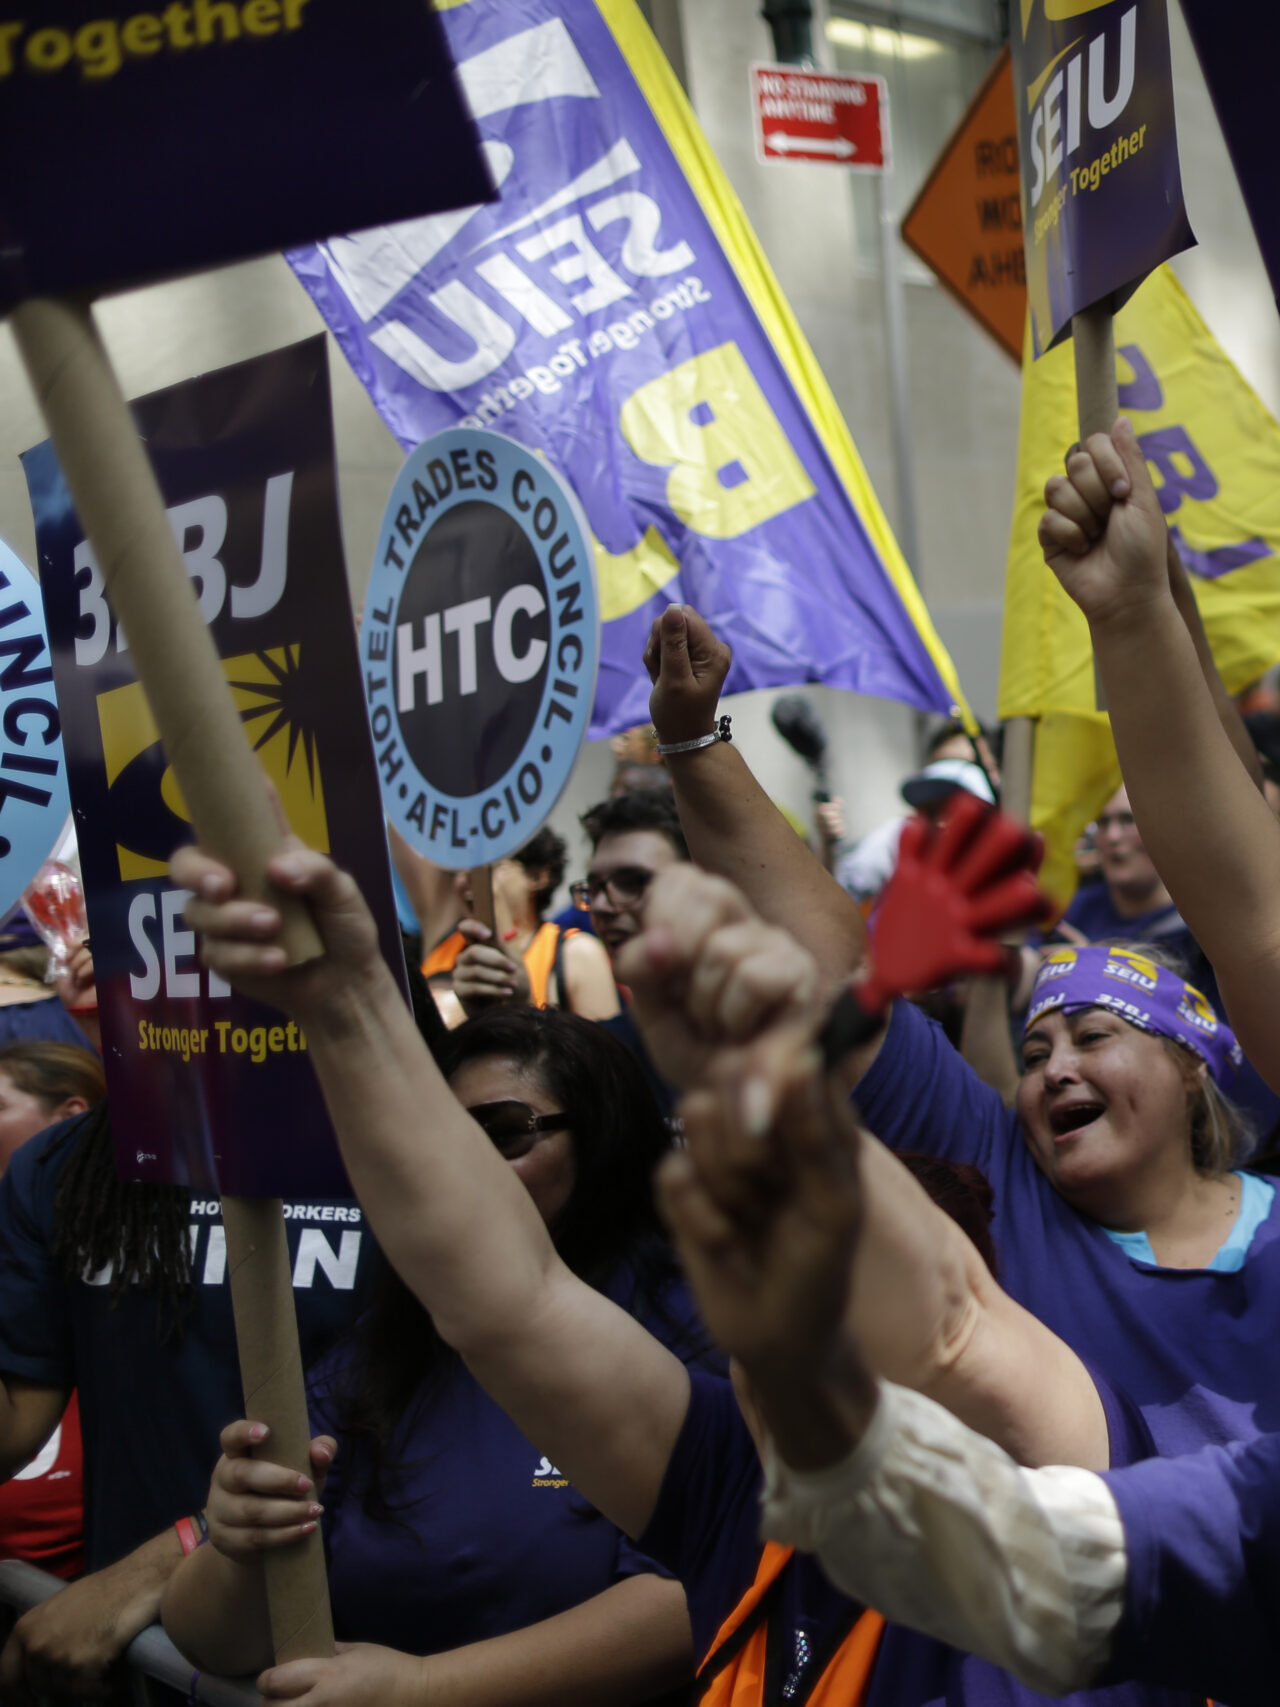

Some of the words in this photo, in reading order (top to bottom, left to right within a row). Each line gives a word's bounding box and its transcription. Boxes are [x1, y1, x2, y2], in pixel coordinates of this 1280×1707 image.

[1030, 4, 1136, 208] SEIU
[1070, 123, 1147, 196] Together
[73, 471, 294, 667] 3BJ
[384, 448, 498, 572] TRADES
[397, 583, 548, 714] HTC
[512, 469, 584, 730] COUNCIL
[368, 597, 404, 785] HOTEL
[405, 762, 543, 848] AFL-CIO
[1103, 963, 1157, 991] SEIU
[138, 1020, 209, 1062] Stronger
